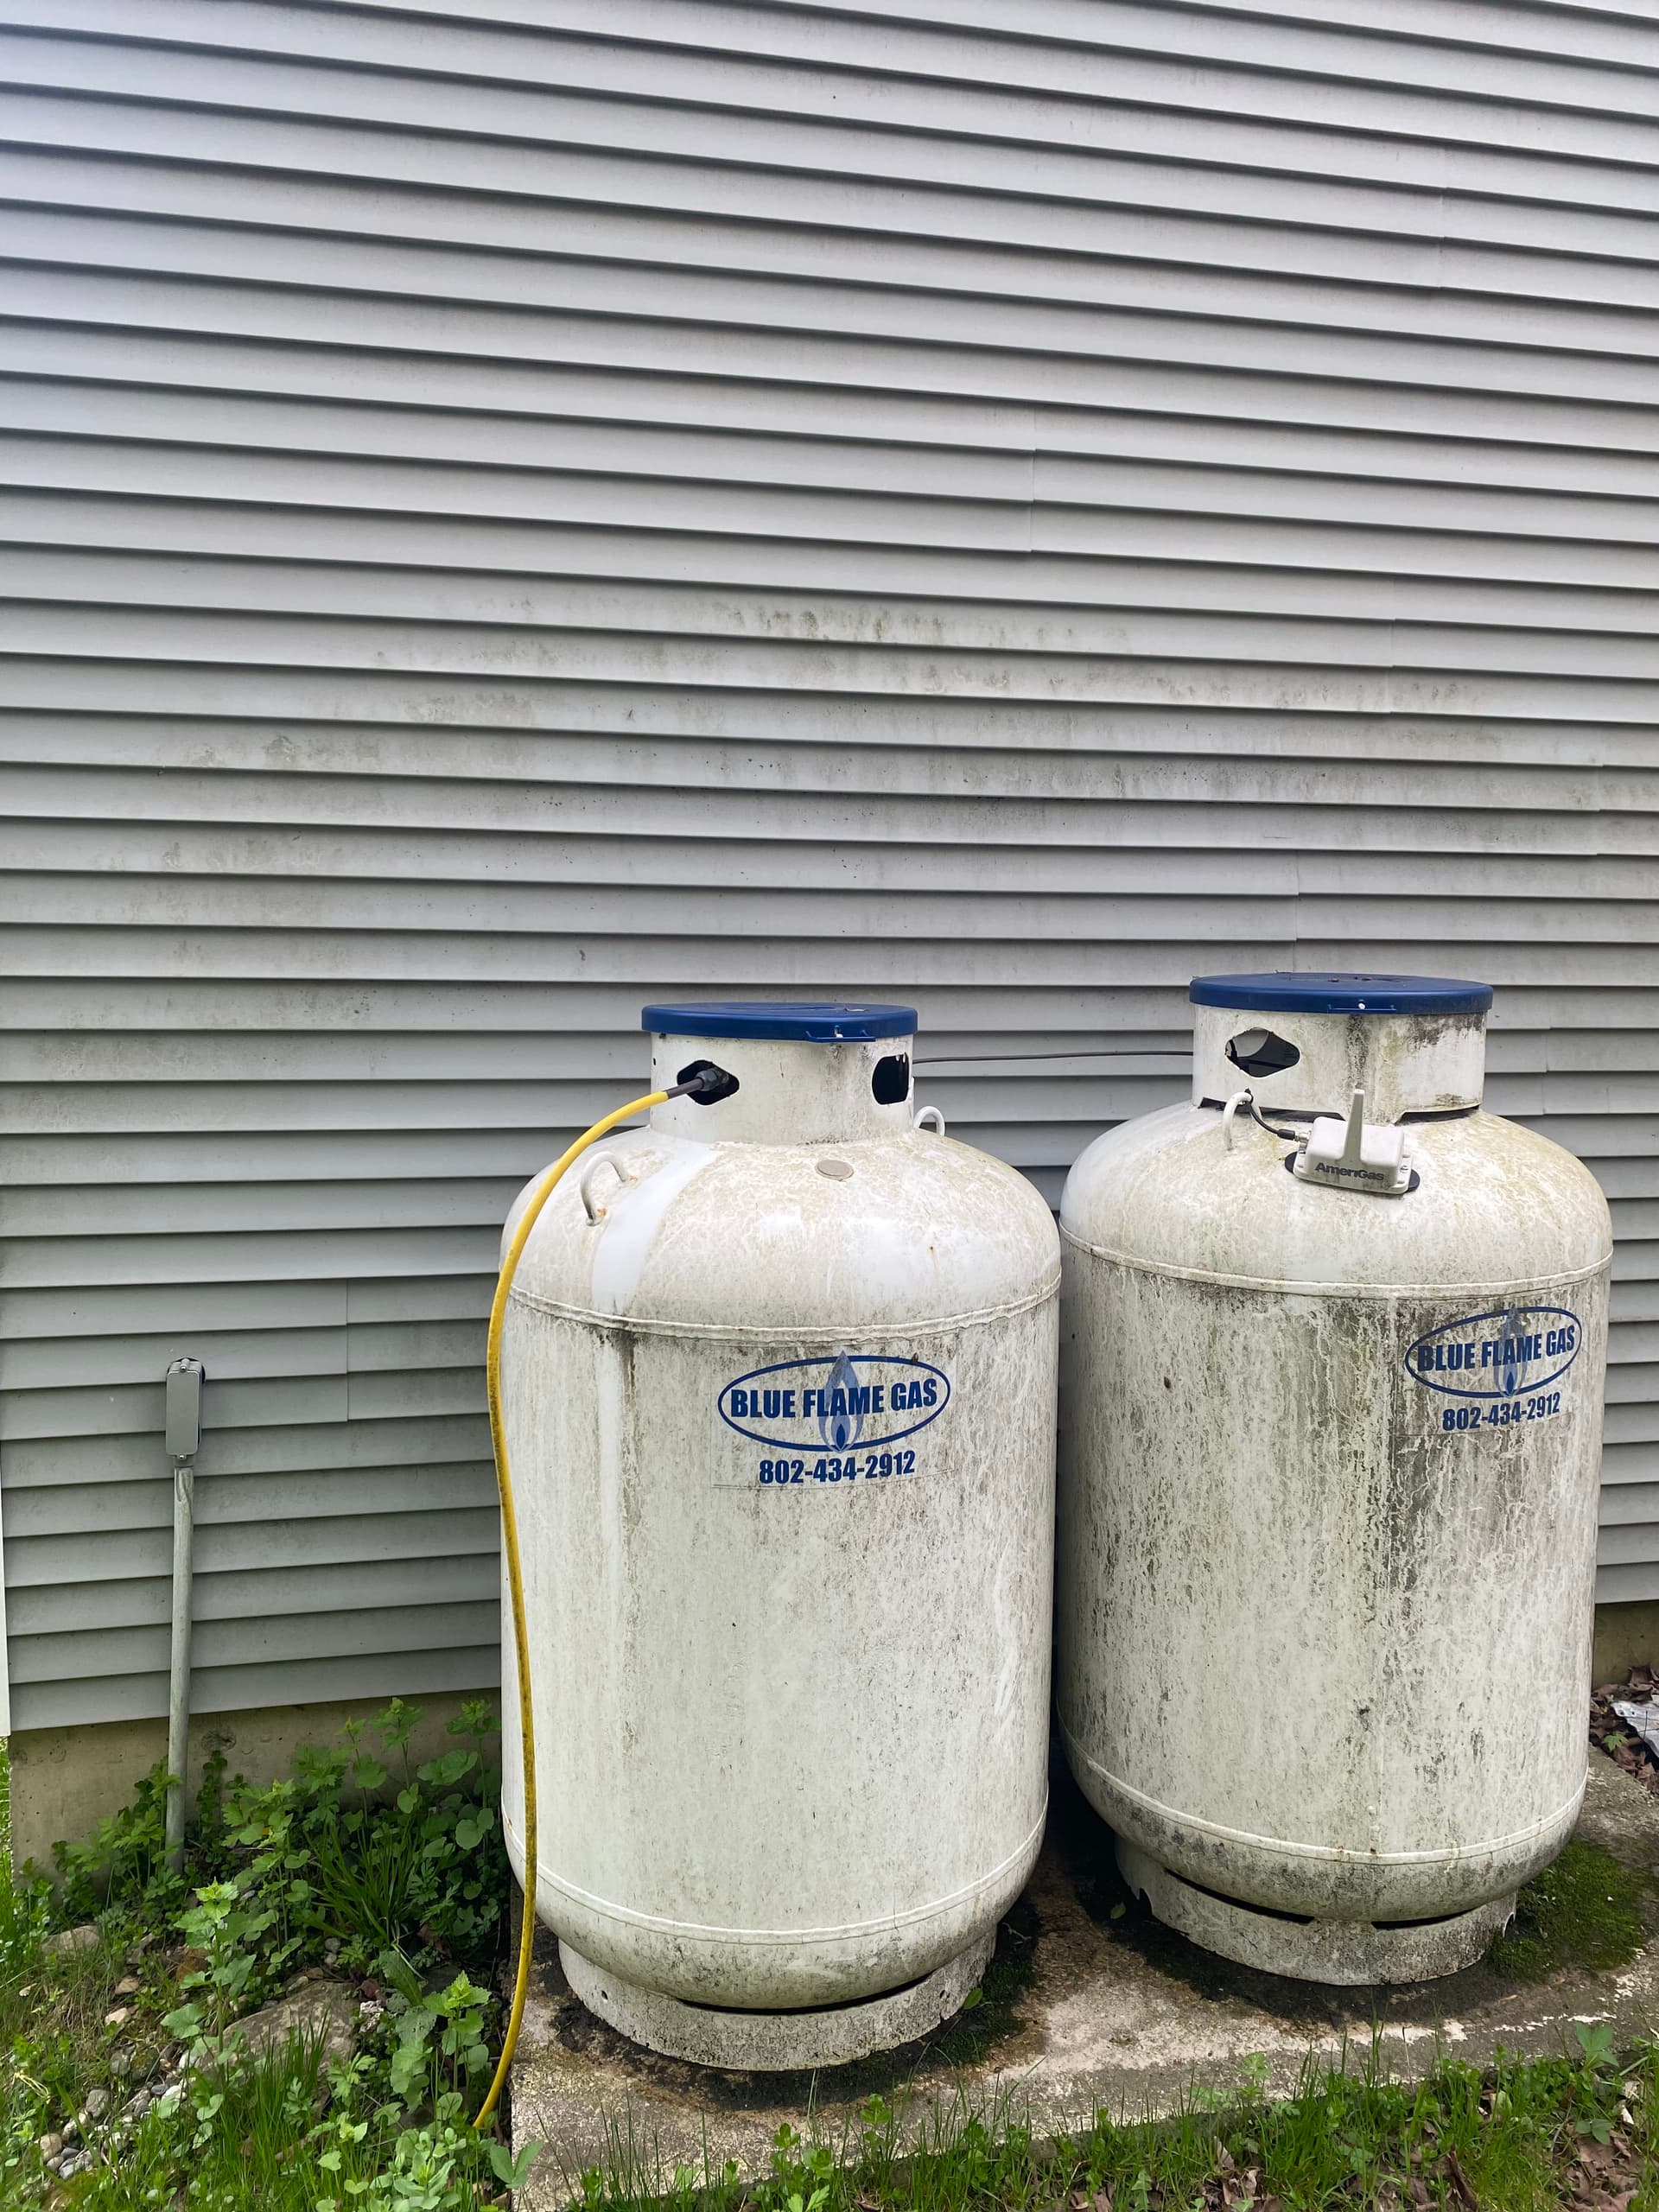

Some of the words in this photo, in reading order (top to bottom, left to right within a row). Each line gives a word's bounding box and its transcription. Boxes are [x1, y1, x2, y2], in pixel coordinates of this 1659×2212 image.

[1314, 1162, 1384, 1181] AmeriGas
[1417, 1343, 1476, 1372] BLUE
[1481, 1333, 1542, 1368] FLAME
[1546, 1325, 1575, 1357] GAS
[730, 1389, 797, 1419] BLUE
[803, 1385, 885, 1418] FLAME
[890, 1378, 938, 1411] GAS
[1441, 1392, 1561, 1432] 802-434-2912
[759, 1450, 916, 1484] 802-434-2912
